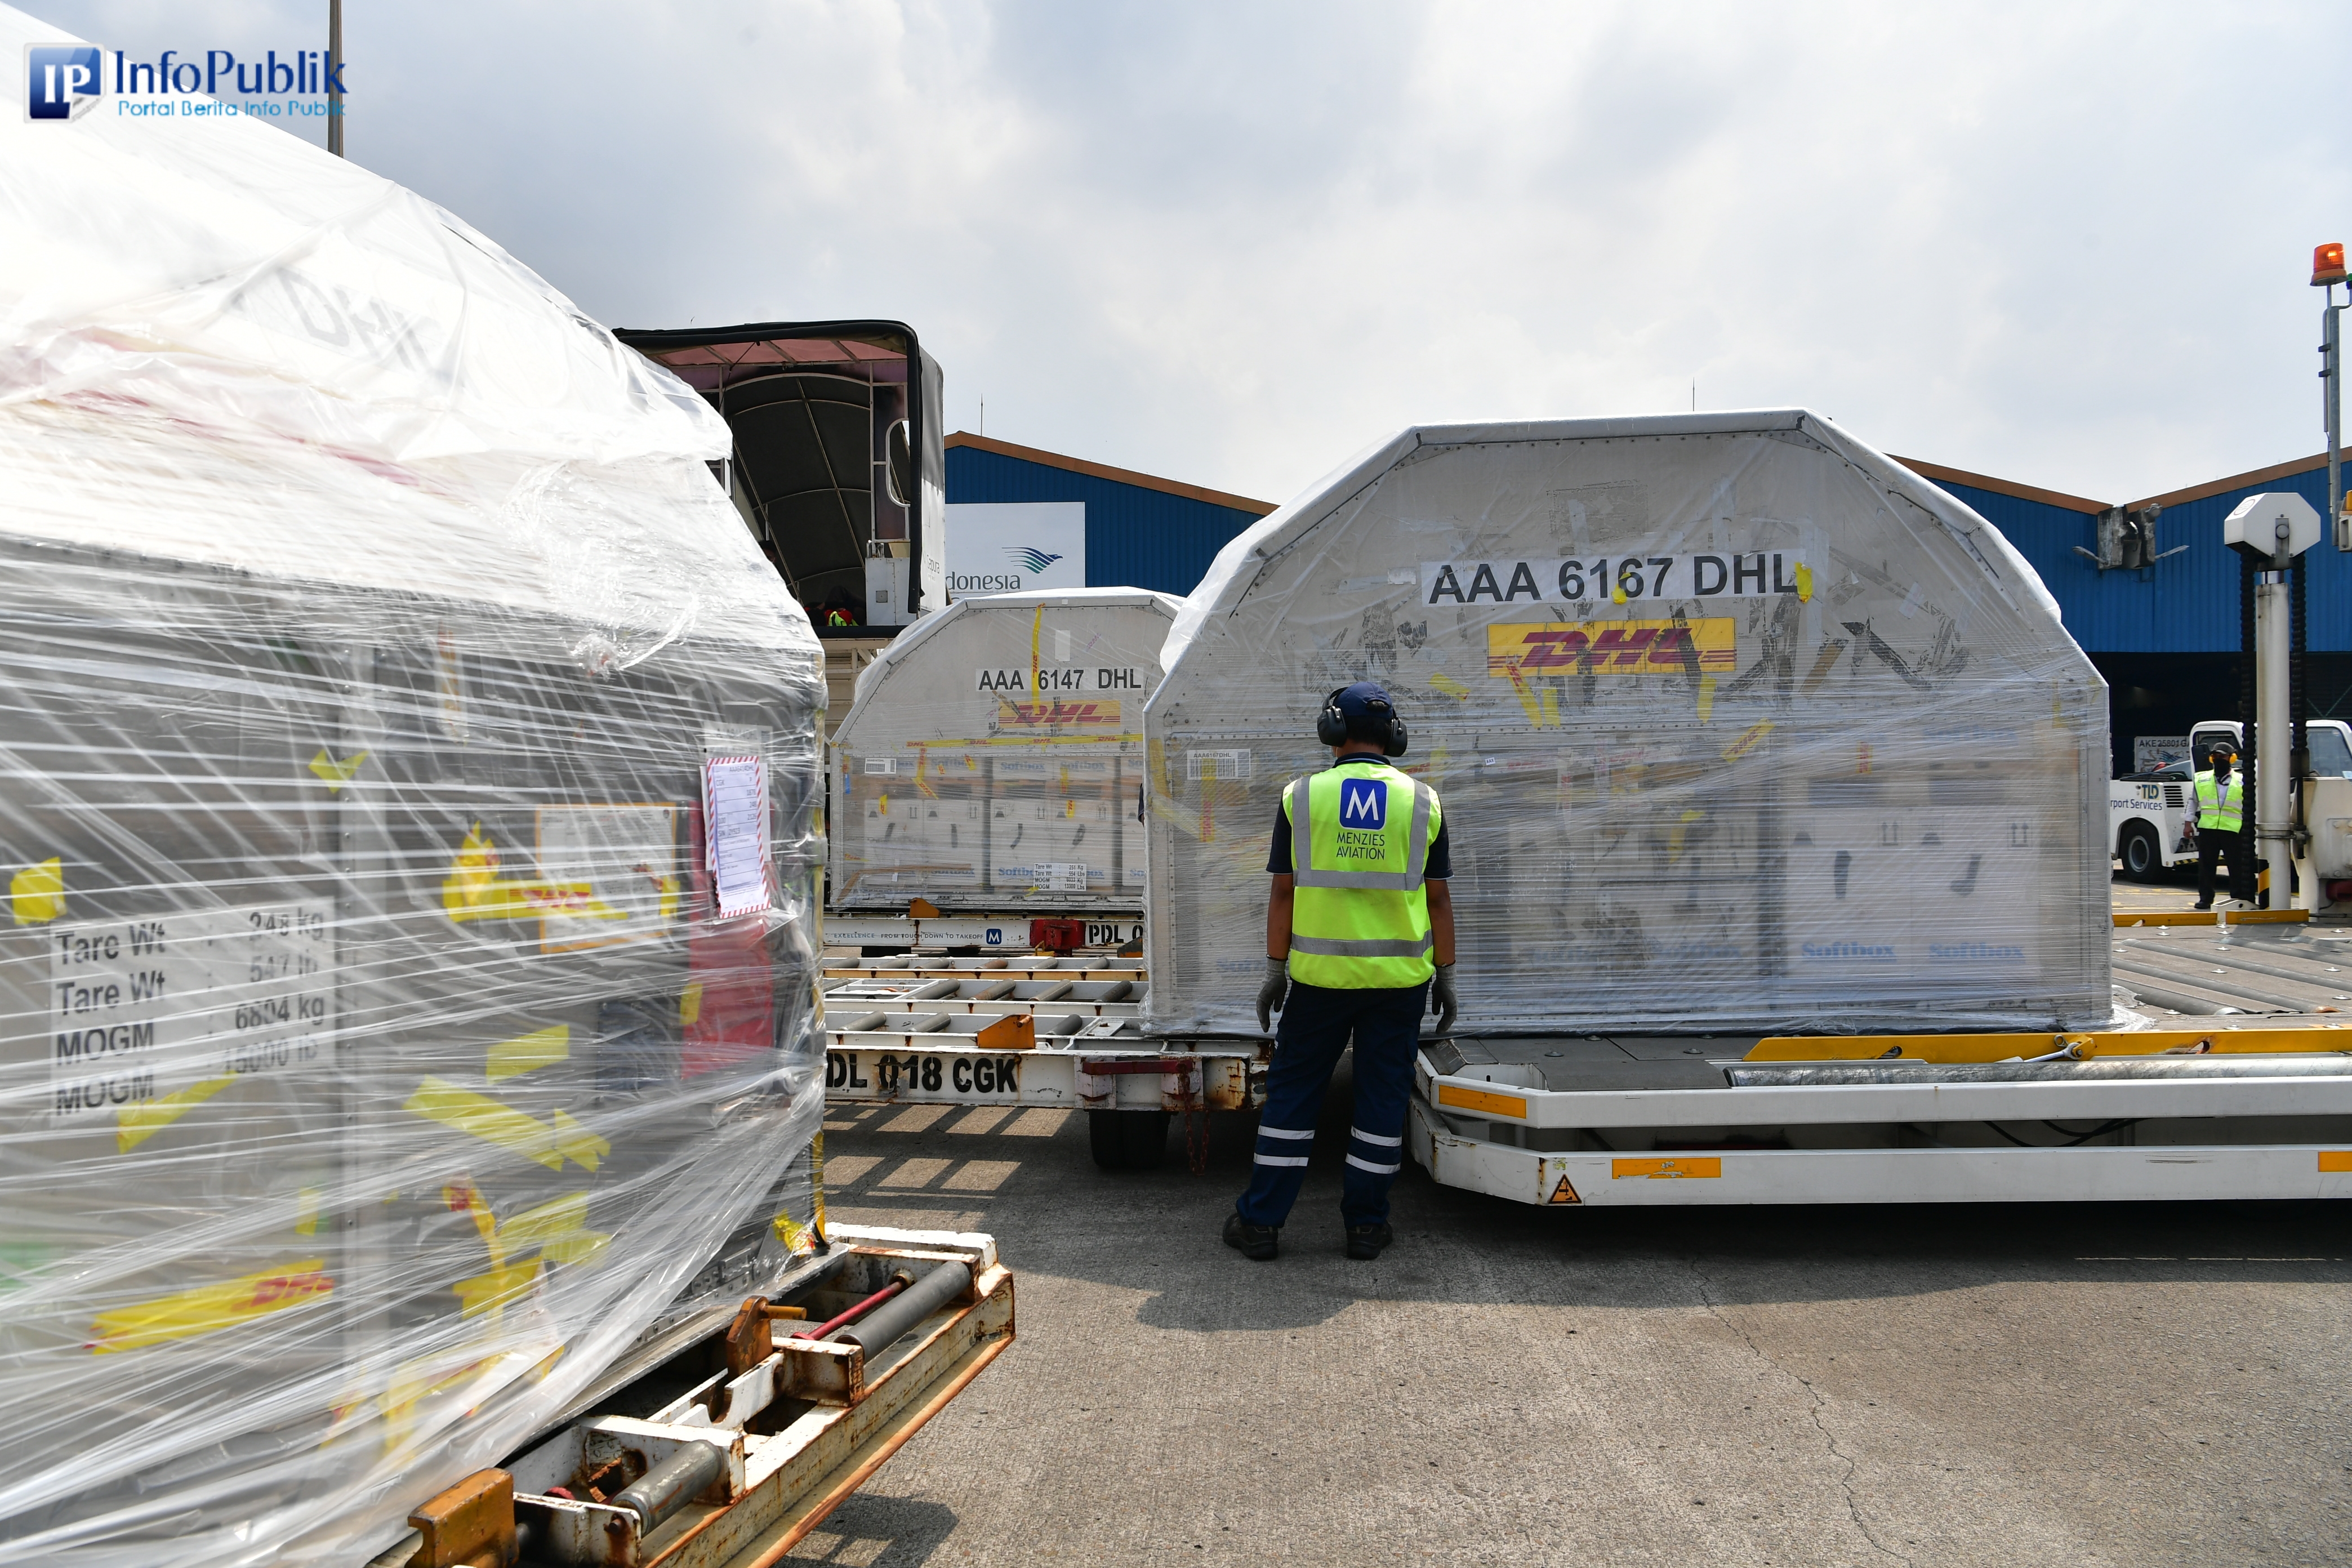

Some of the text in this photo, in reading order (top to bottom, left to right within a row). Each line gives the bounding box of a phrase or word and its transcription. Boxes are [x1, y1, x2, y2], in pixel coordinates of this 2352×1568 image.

[1428, 554, 1798, 604] AAA 6167 DHL
[1521, 628, 1703, 667] DHL
[978, 668, 1142, 690] AAA 6147 DHL
[1013, 704, 1103, 724] DHL
[1000, 761, 1045, 770] Softbox
[2141, 784, 2160, 800] TLD
[1345, 786, 1379, 821] M
[2130, 799, 2163, 811] Services
[1337, 832, 1385, 847] MENZIES
[1336, 846, 1385, 861] AVIATION
[55, 930, 119, 965] Tare
[129, 922, 166, 956] Wt
[987, 931, 1000, 943] M
[1089, 924, 1124, 944] PDL
[1801, 942, 1895, 957] Softbox
[56, 982, 119, 1016] Tare
[128, 970, 166, 1005] Wt
[56, 1017, 154, 1066] MOGM
[298, 994, 324, 1026] kg
[879, 1054, 943, 1092] 018
[952, 1057, 1018, 1093] CGK
[56, 1072, 154, 1116] MOGM
